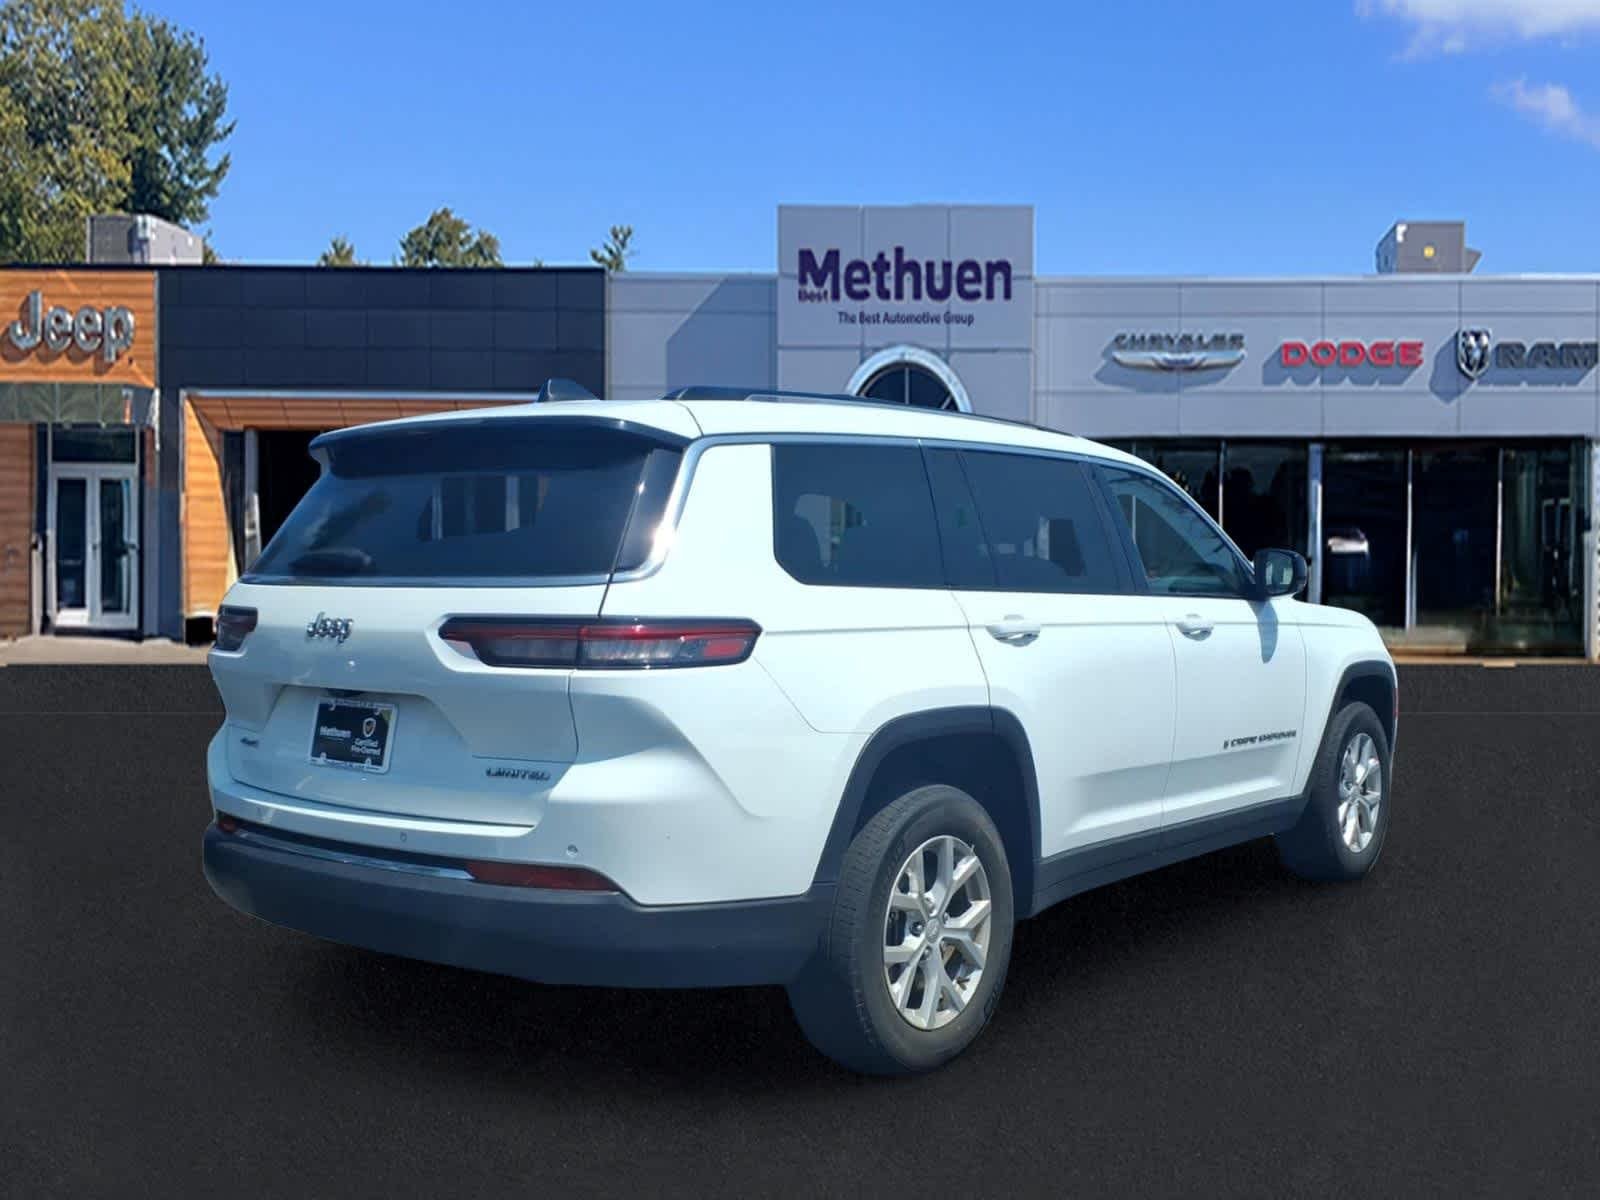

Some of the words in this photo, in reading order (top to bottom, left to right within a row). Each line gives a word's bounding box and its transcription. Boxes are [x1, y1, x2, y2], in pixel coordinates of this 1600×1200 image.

[798, 246, 1012, 301] Methuen
[9, 290, 135, 363] Jeep
[838, 312, 856, 325] The
[859, 312, 880, 325] Best
[883, 312, 940, 325] Automotive
[943, 312, 975, 327] Group
[1114, 333, 1244, 352] CHRYSLER
[1282, 341, 1424, 367] DODGE
[1496, 342, 1599, 369] RAM
[306, 611, 353, 643] Jeep
